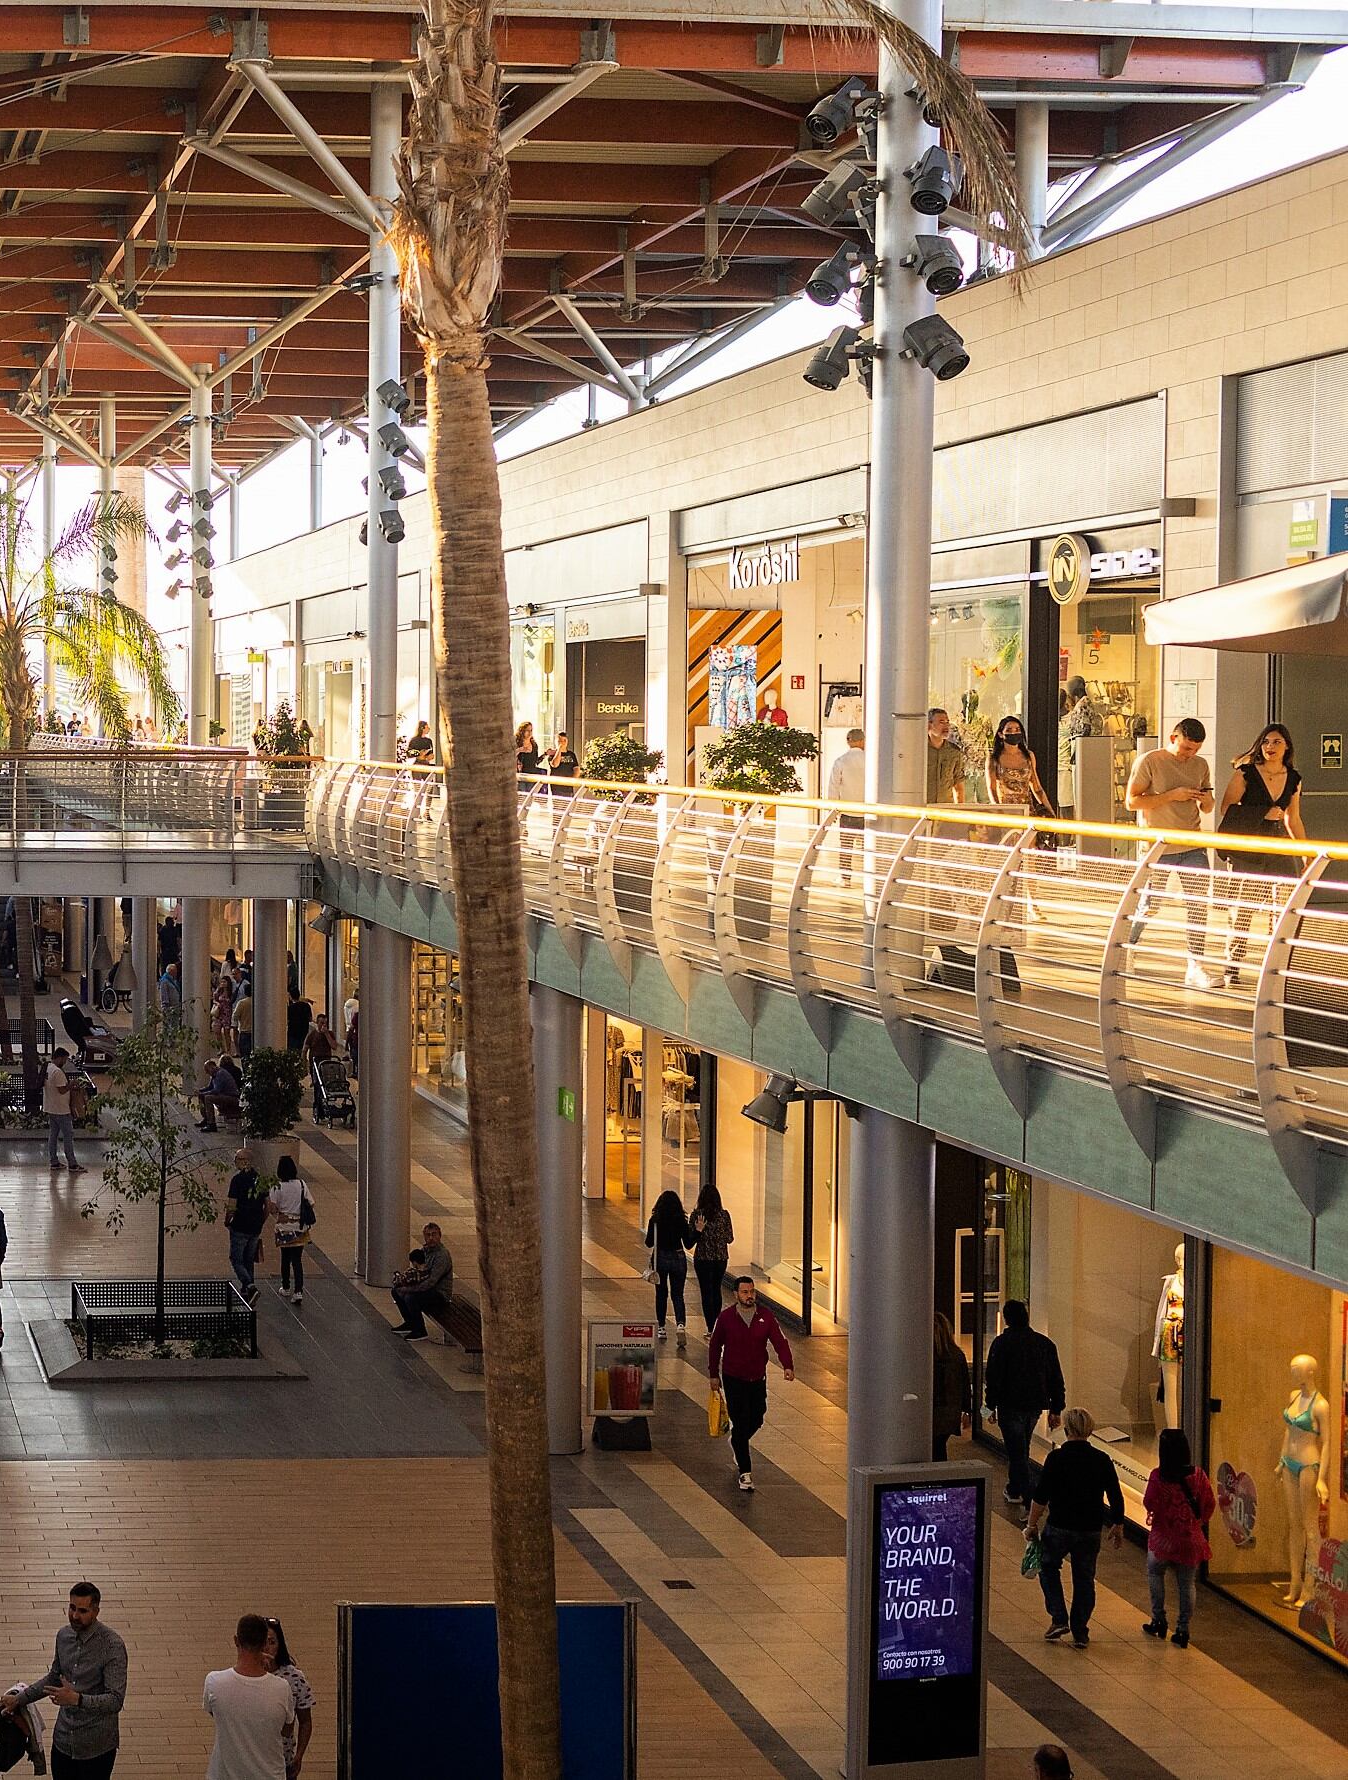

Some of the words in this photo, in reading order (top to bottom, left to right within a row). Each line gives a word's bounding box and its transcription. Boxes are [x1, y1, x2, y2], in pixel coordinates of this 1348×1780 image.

[597, 702, 639, 714] Bershka
[906, 1493, 947, 1505] squirrel
[886, 1524, 937, 1546] YOUR
[885, 1546, 956, 1569] BRAND,
[884, 1577, 923, 1598] THE
[884, 1598, 958, 1621] WORLD.
[882, 1658, 903, 1671] 900
[904, 1657, 919, 1669] 90
[920, 1656, 931, 1667] 17
[931, 1655, 946, 1666] 39
